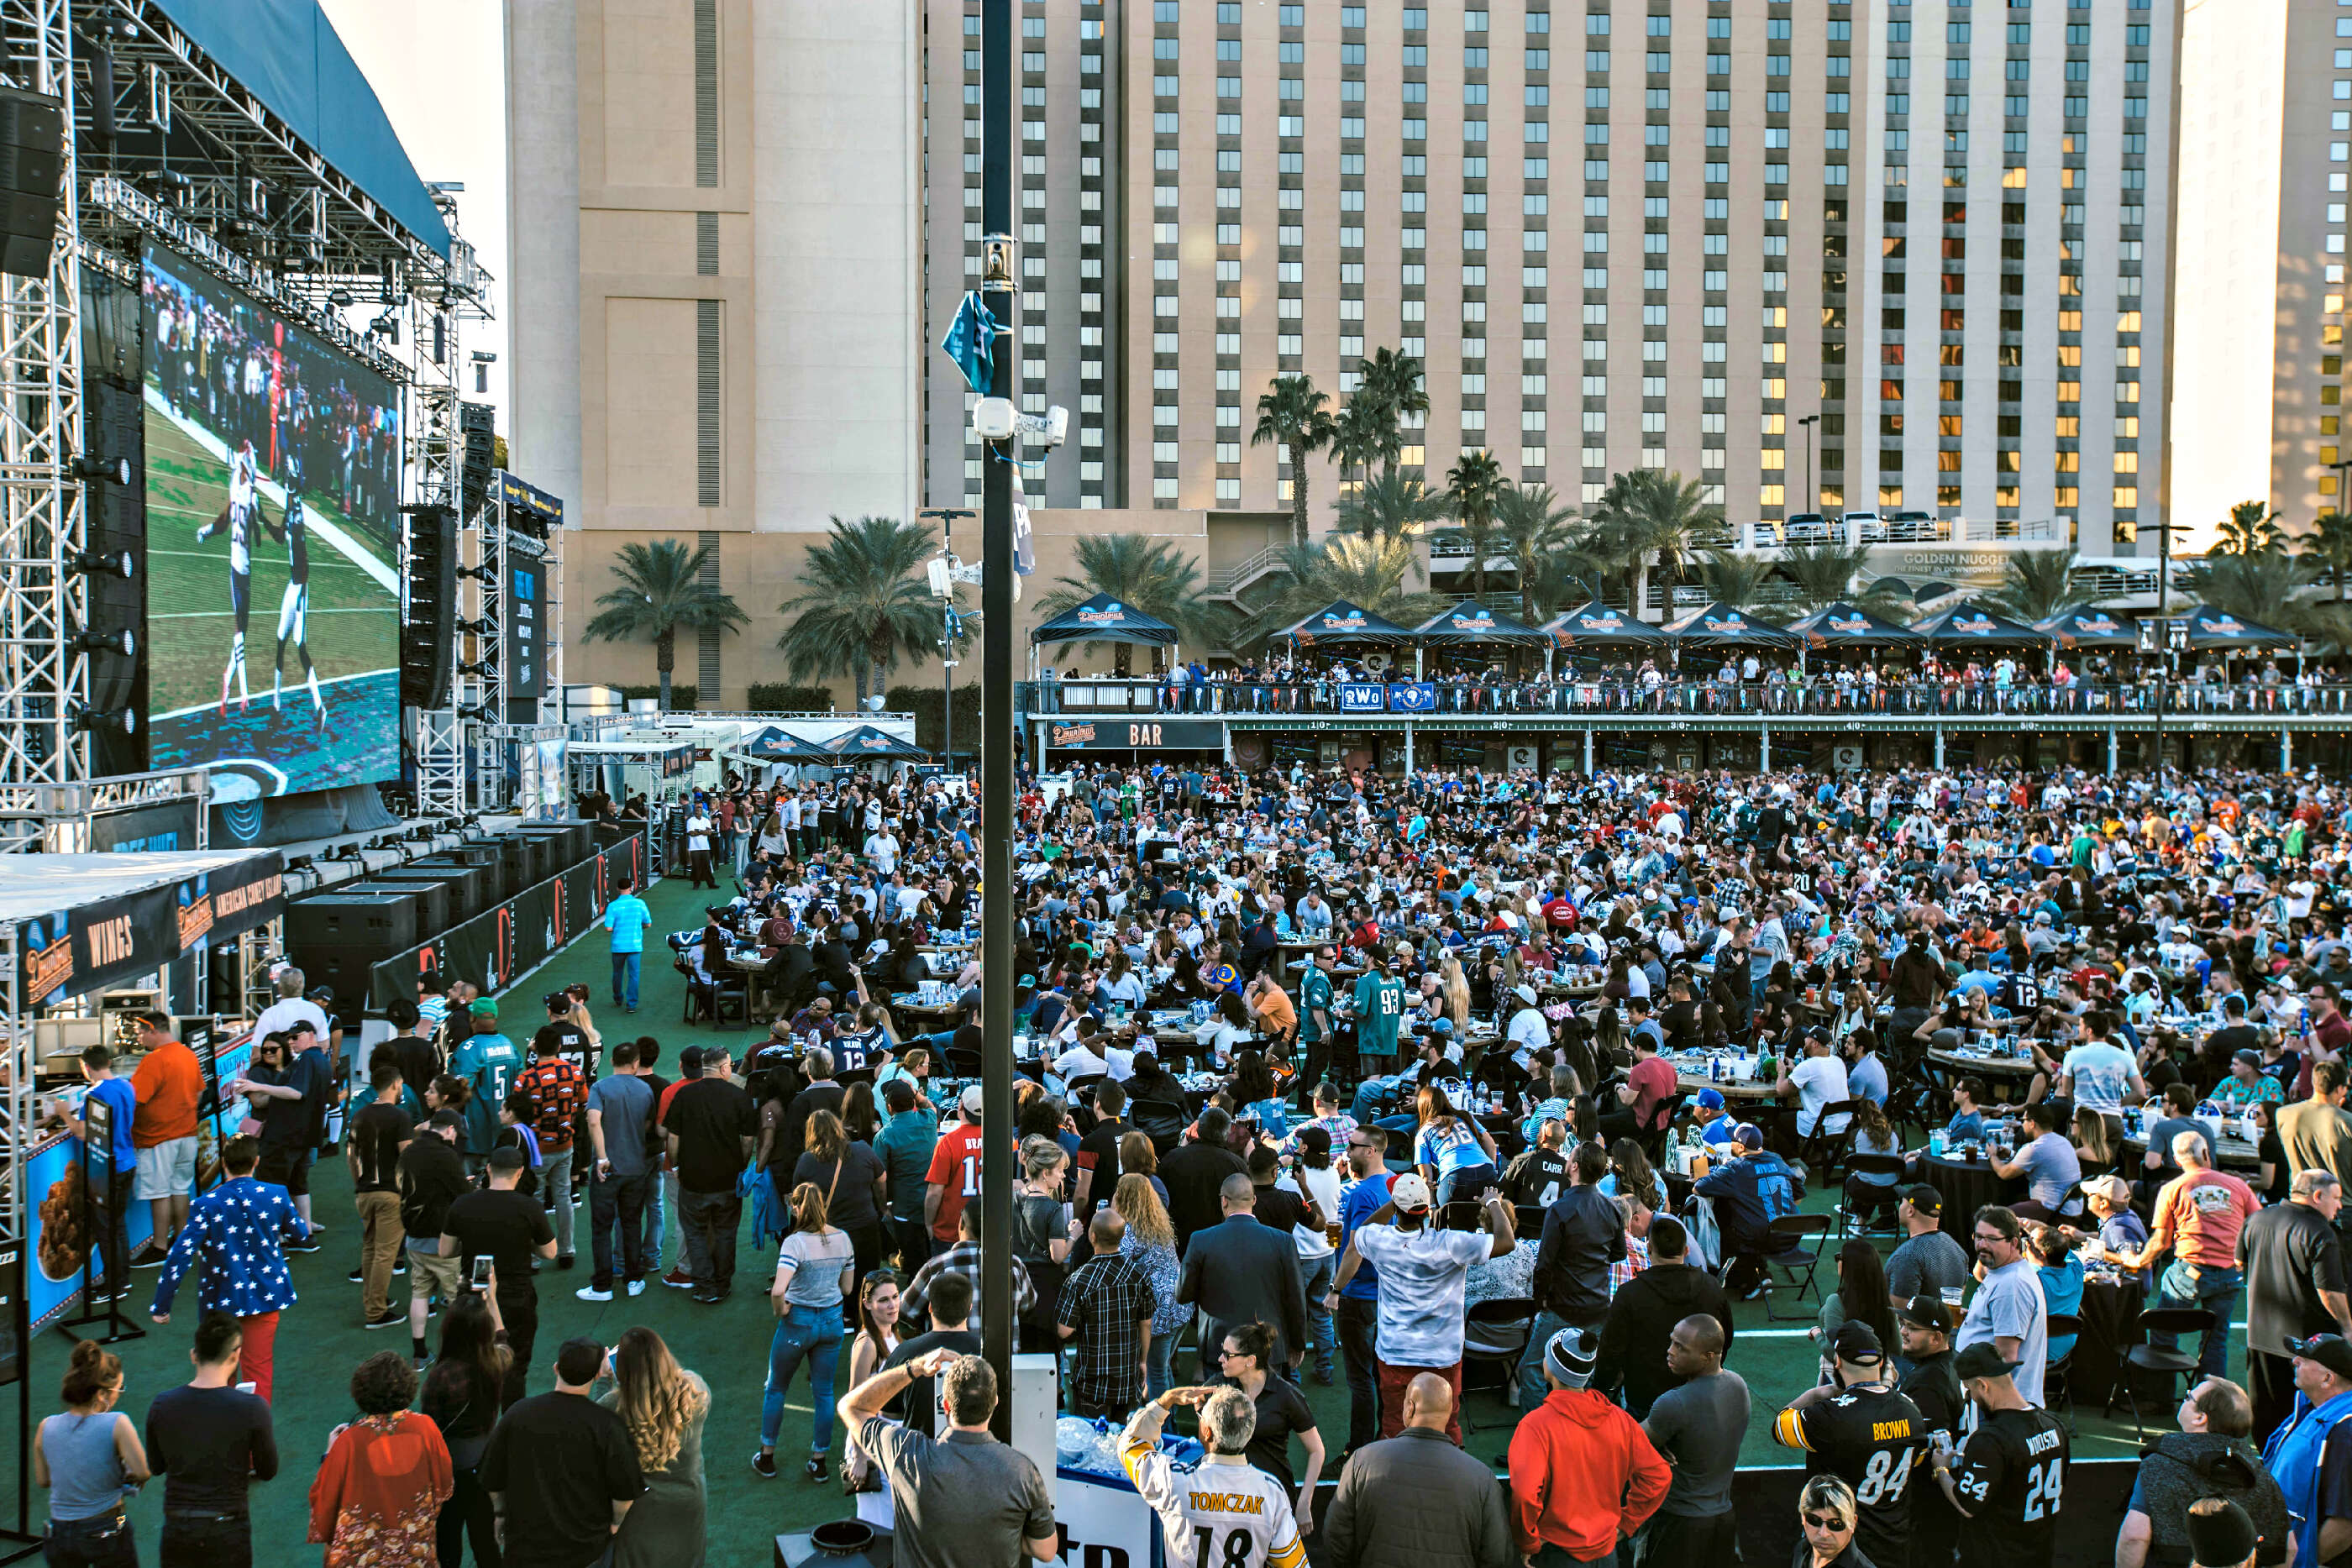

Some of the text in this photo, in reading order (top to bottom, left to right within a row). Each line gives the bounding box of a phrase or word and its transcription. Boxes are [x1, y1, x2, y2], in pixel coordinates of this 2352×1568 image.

[1904, 553, 2010, 565] GOLDEN NUGGET
[1129, 724, 1162, 746] BAR
[1164, 784, 1173, 793] 82
[1915, 821, 1923, 834] 4
[2261, 844, 2277, 859] 36
[597, 855, 607, 915] D
[1793, 874, 1809, 891] 20
[216, 887, 248, 918] AMERICAN
[247, 880, 265, 906] CONEY
[265, 873, 282, 899] ISLAND
[546, 878, 565, 952] the D
[1213, 901, 1230, 920] 43
[87, 915, 134, 968] WINGS
[486, 908, 512, 993] the D
[1380, 989, 1399, 1015] 93
[2016, 986, 2037, 1008] 12
[561, 1034, 579, 1046] MACK
[843, 1051, 865, 1070] 12
[494, 1065, 506, 1100] 5
[964, 1138, 982, 1150] BRA
[961, 1156, 982, 1197] 1
[1542, 1160, 1562, 1174] CARR
[1539, 1180, 1560, 1208] 4
[1872, 1419, 1911, 1441] BROWN
[2025, 1429, 2060, 1456] WOODSON
[1856, 1446, 1915, 1506] 84
[1959, 1471, 1989, 1502] 24
[2024, 1458, 2062, 1522] 24
[1189, 1492, 1264, 1515] TOMCZAK
[1194, 1525, 1252, 1568] 18
